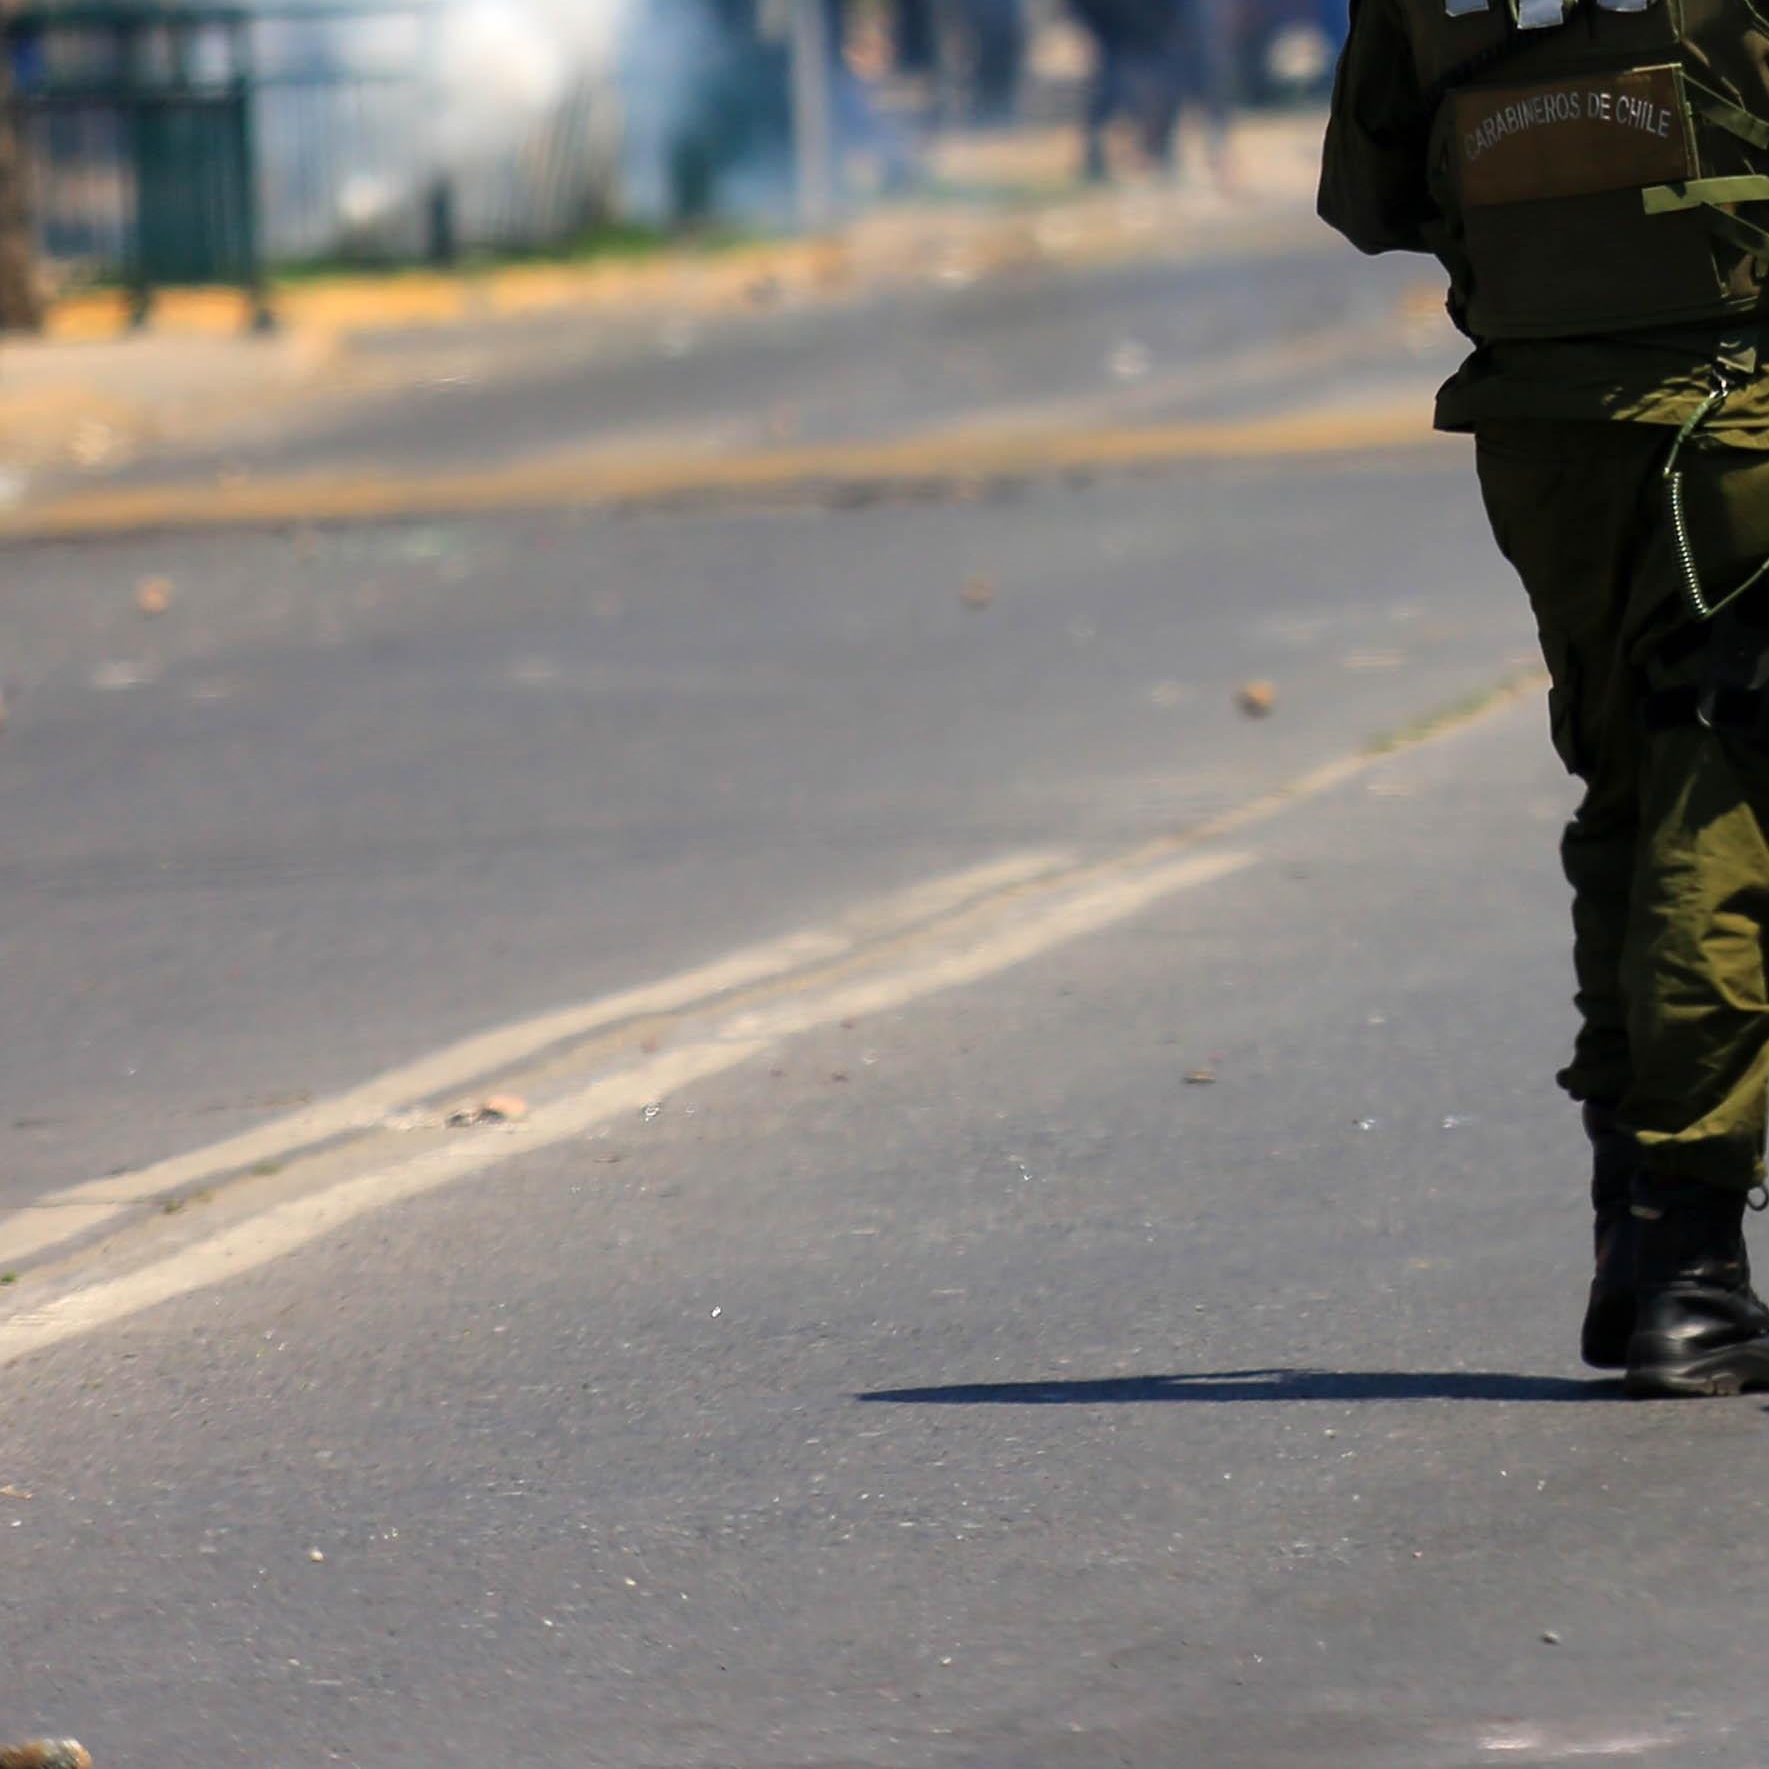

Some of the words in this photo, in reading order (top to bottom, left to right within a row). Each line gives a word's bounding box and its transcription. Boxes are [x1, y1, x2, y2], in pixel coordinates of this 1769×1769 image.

[1463, 92, 1581, 160] CARABINEROS
[1587, 92, 1611, 121] DE
[1615, 95, 1672, 139] CHILE
